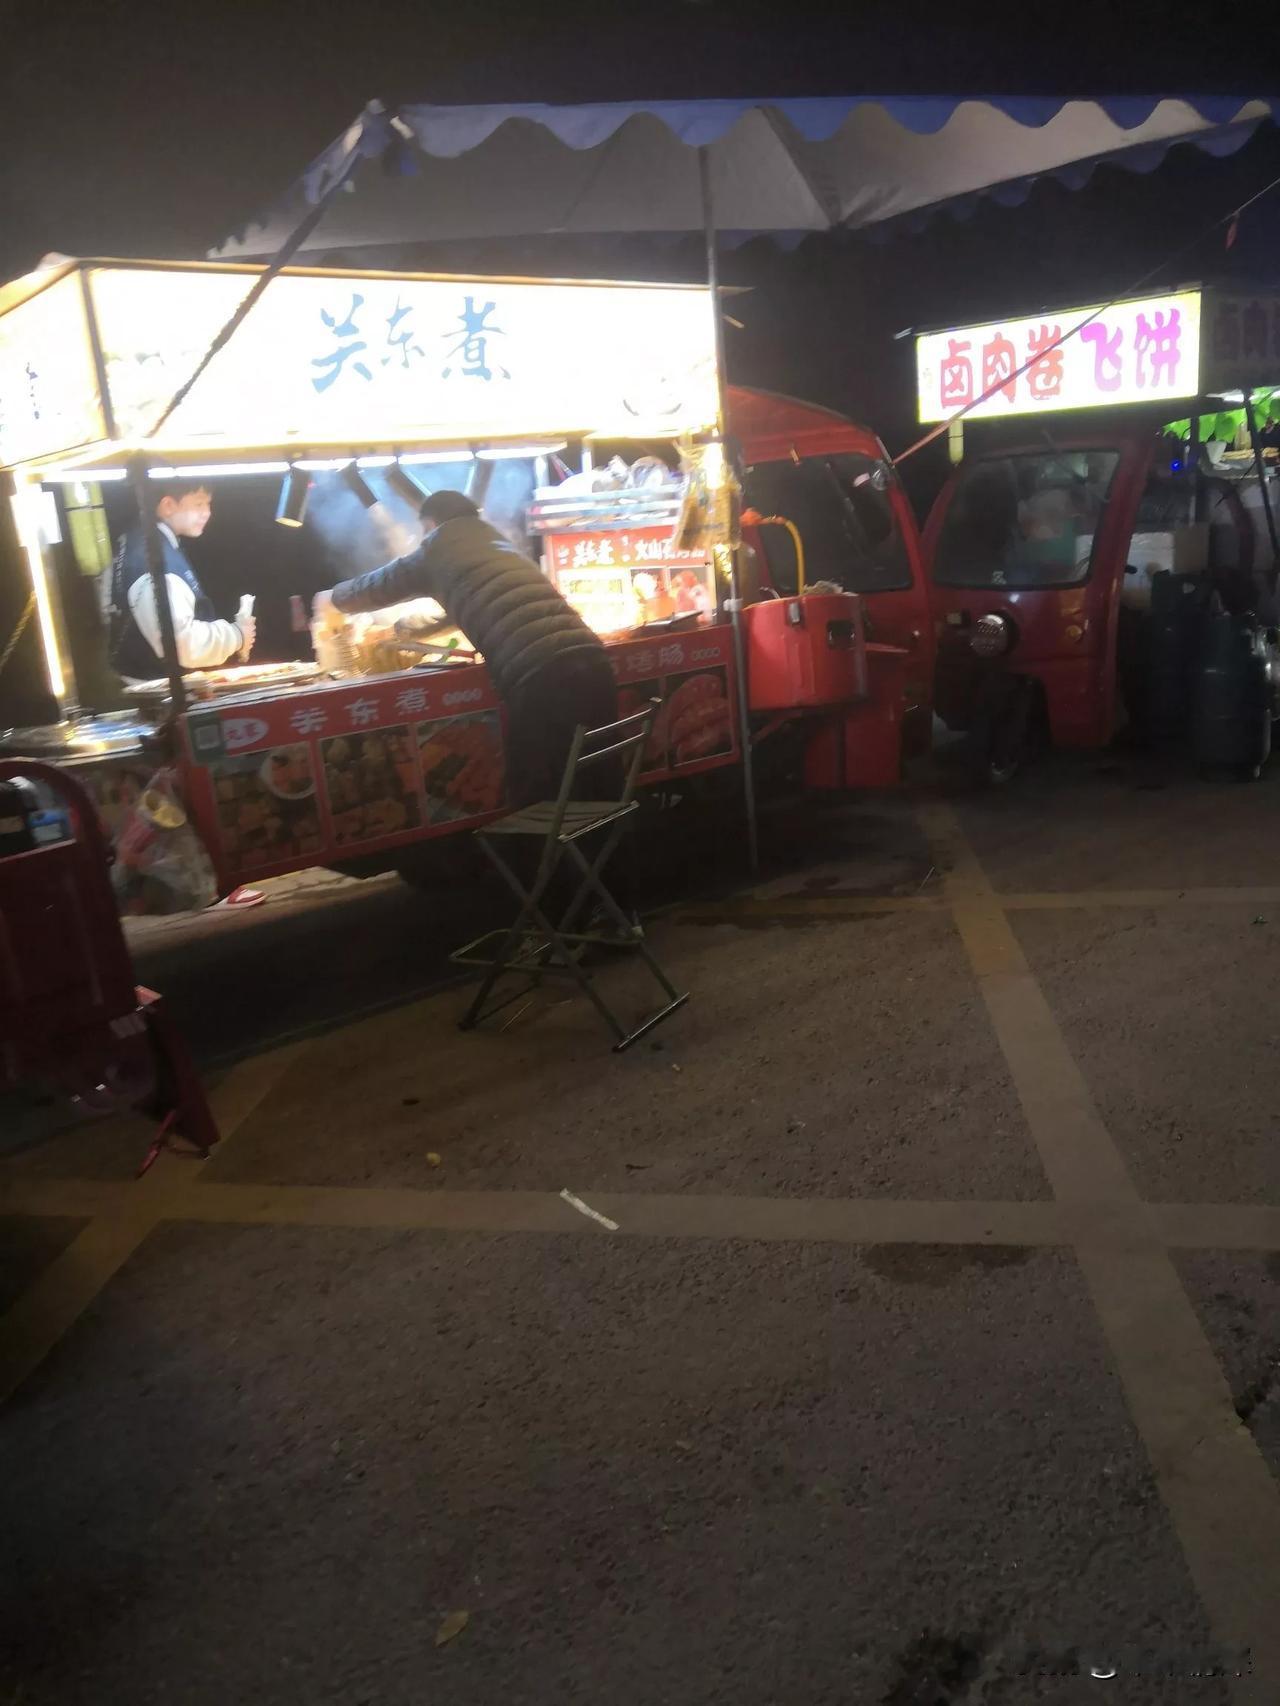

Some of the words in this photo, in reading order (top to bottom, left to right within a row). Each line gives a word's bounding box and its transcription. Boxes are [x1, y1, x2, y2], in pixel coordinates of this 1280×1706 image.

[311, 293, 511, 393] 关东煮
[940, 324, 1064, 409] 卤肉卷
[1080, 307, 1181, 392] 飞饼
[289, 687, 430, 735] 关东煮
